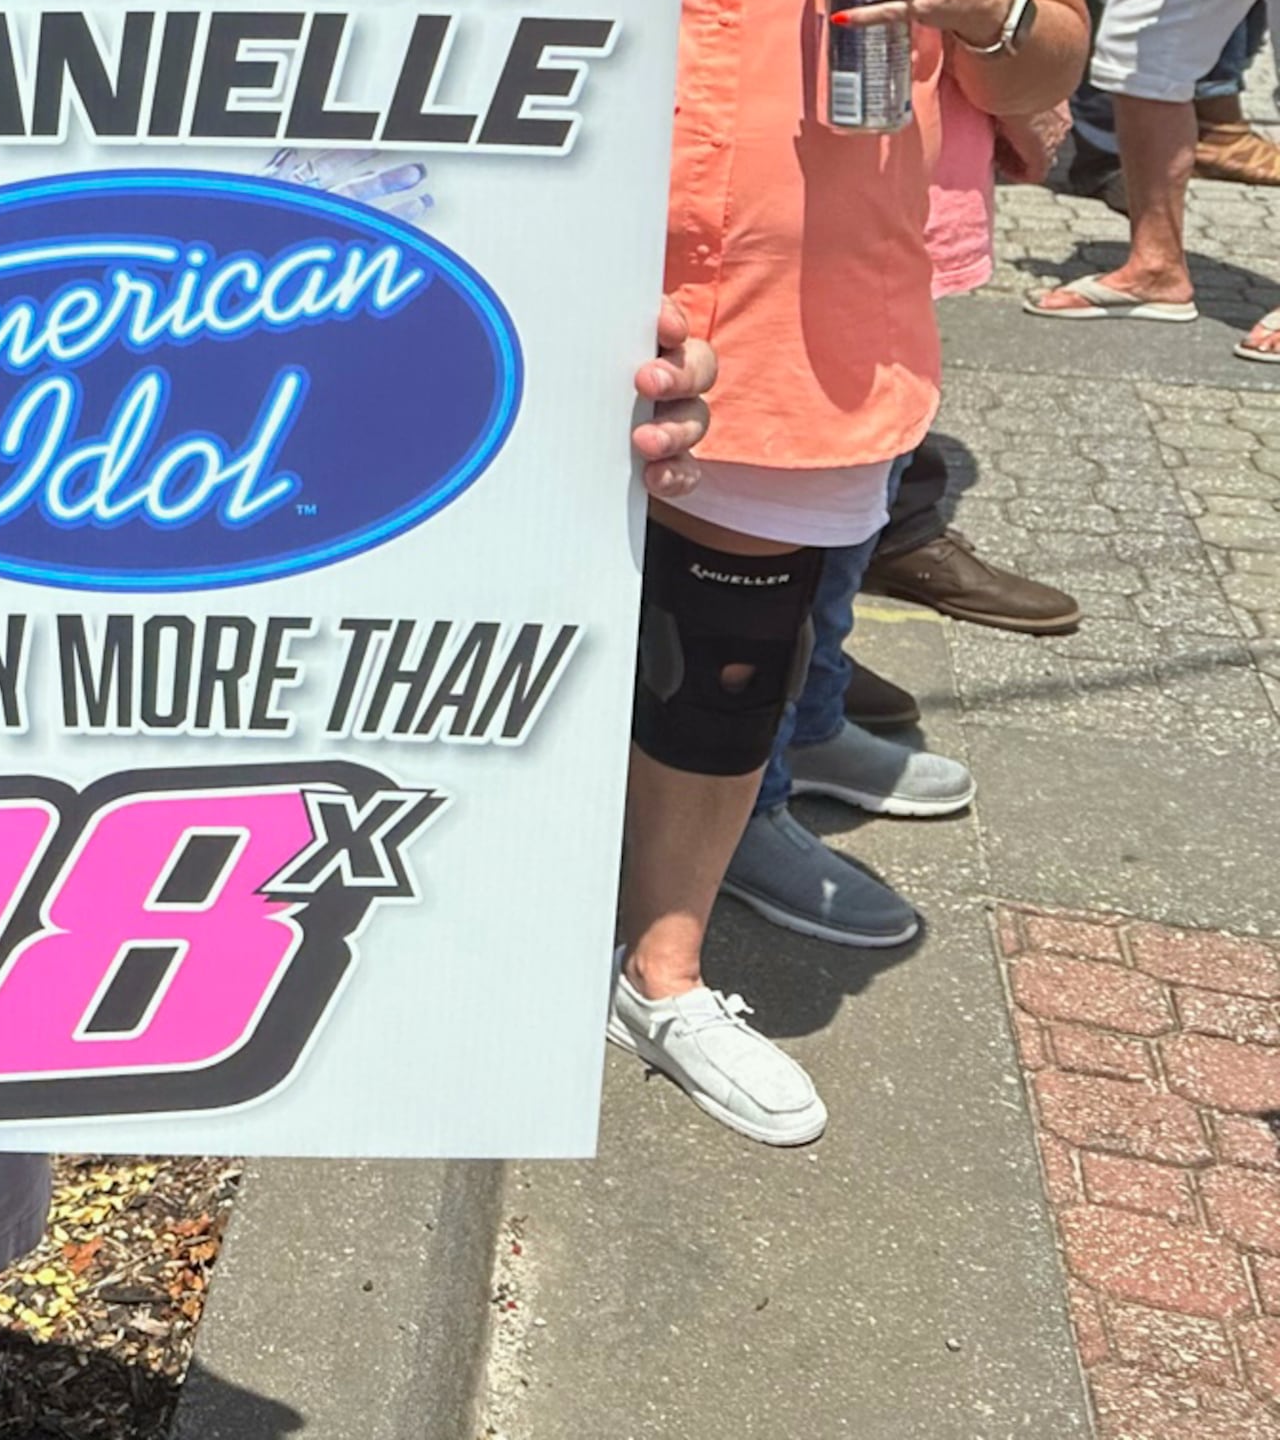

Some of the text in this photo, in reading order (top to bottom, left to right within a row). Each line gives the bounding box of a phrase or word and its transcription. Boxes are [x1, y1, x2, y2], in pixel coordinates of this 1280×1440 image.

[702, 569, 790, 585] MUELLER
[56, 614, 313, 730] MORE
[326, 616, 579, 739] THAN
